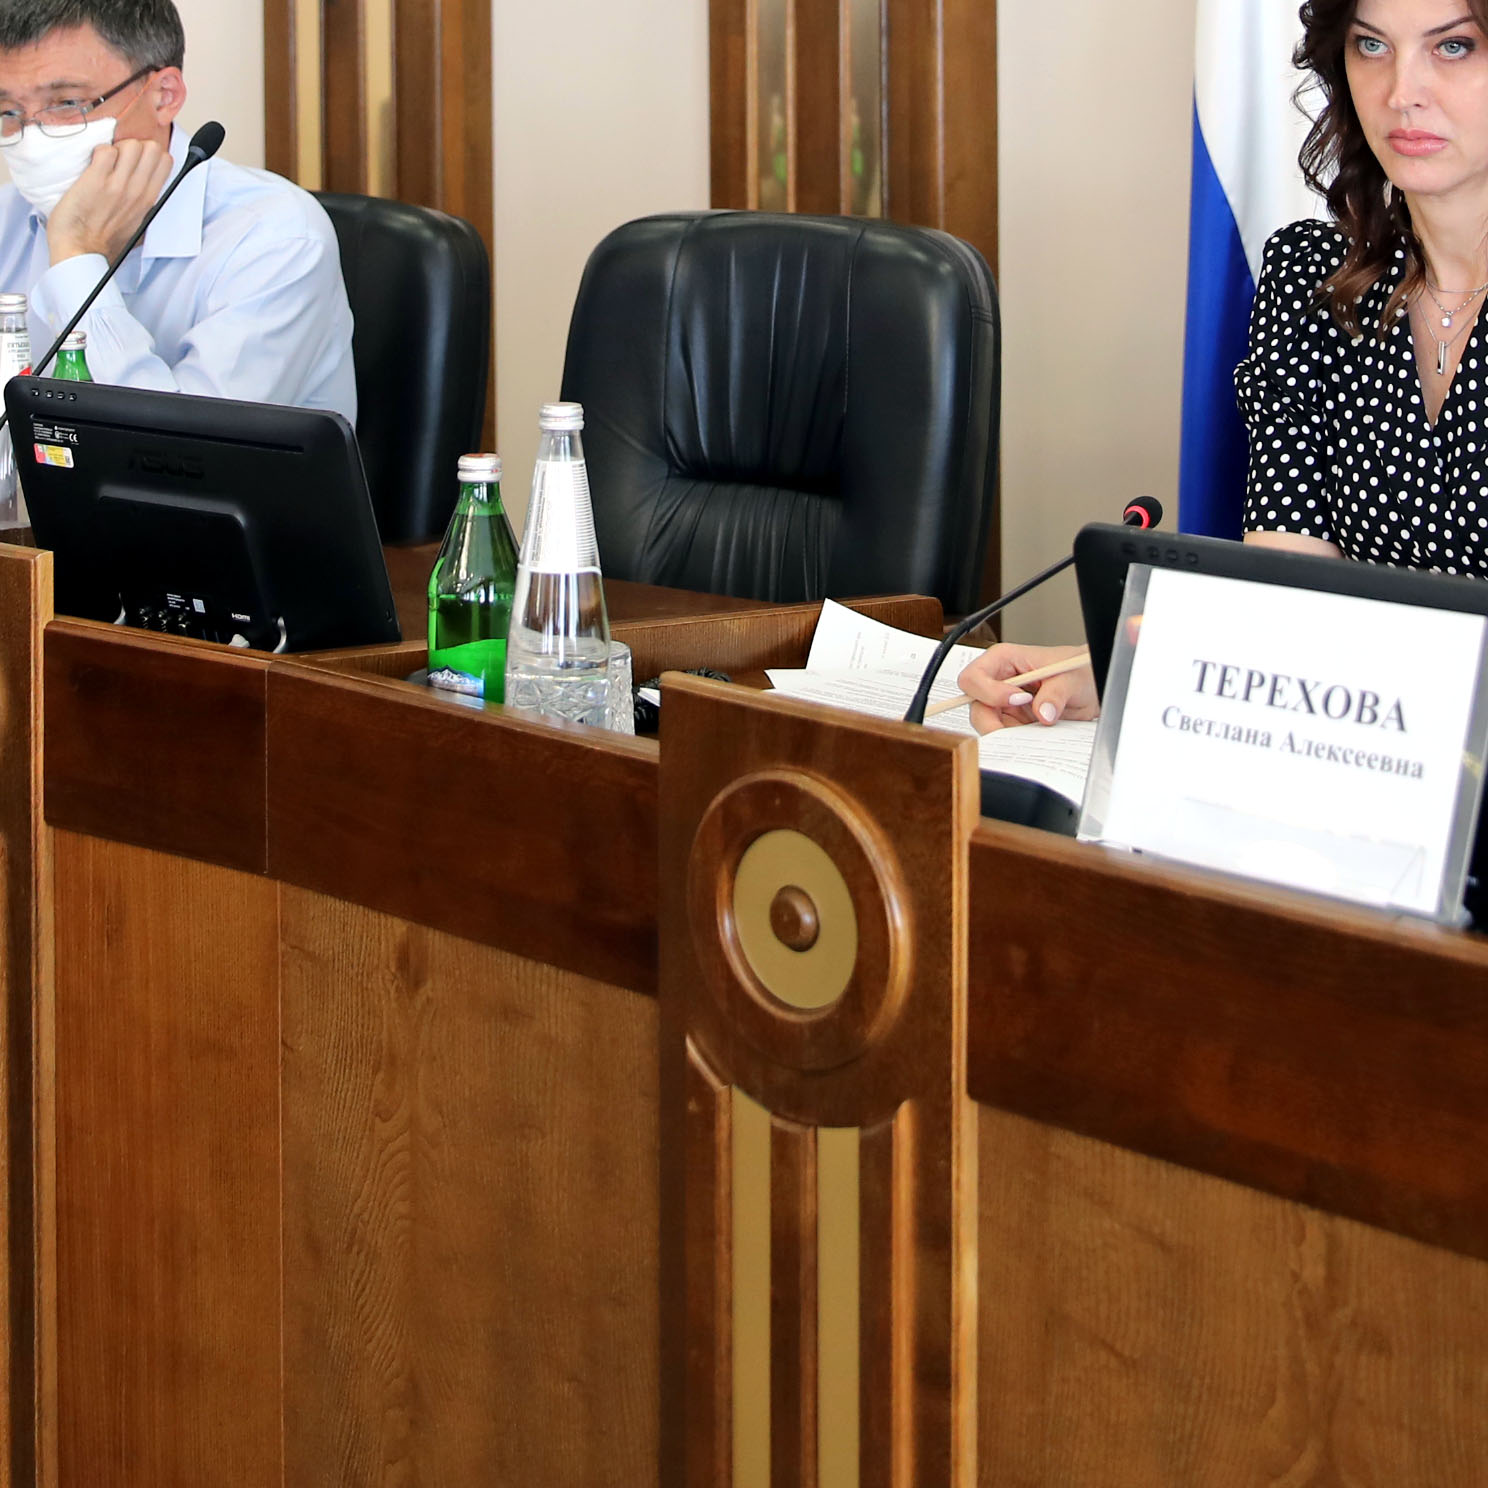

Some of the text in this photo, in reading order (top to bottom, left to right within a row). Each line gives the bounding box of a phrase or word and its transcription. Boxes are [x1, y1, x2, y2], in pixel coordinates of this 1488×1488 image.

[1192, 658, 1408, 733] ТЕРЕХОВА
[1161, 705, 1424, 780] Светлана Алексеевна
